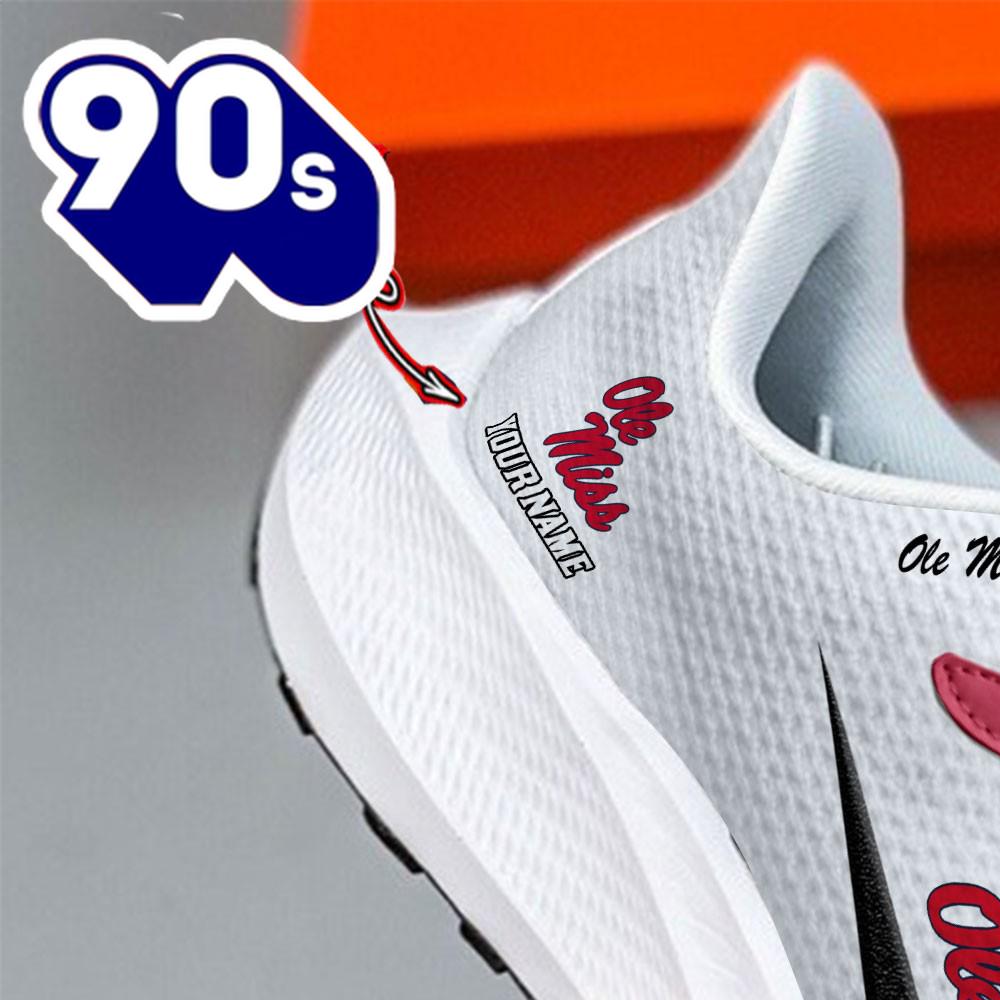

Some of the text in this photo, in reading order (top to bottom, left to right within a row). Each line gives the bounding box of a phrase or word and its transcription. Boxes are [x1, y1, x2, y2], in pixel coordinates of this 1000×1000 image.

[602, 376, 674, 446] Ole
[485, 412, 596, 579] YOUR NAME
[543, 411, 630, 532] Miss
[898, 533, 950, 576] Ole
